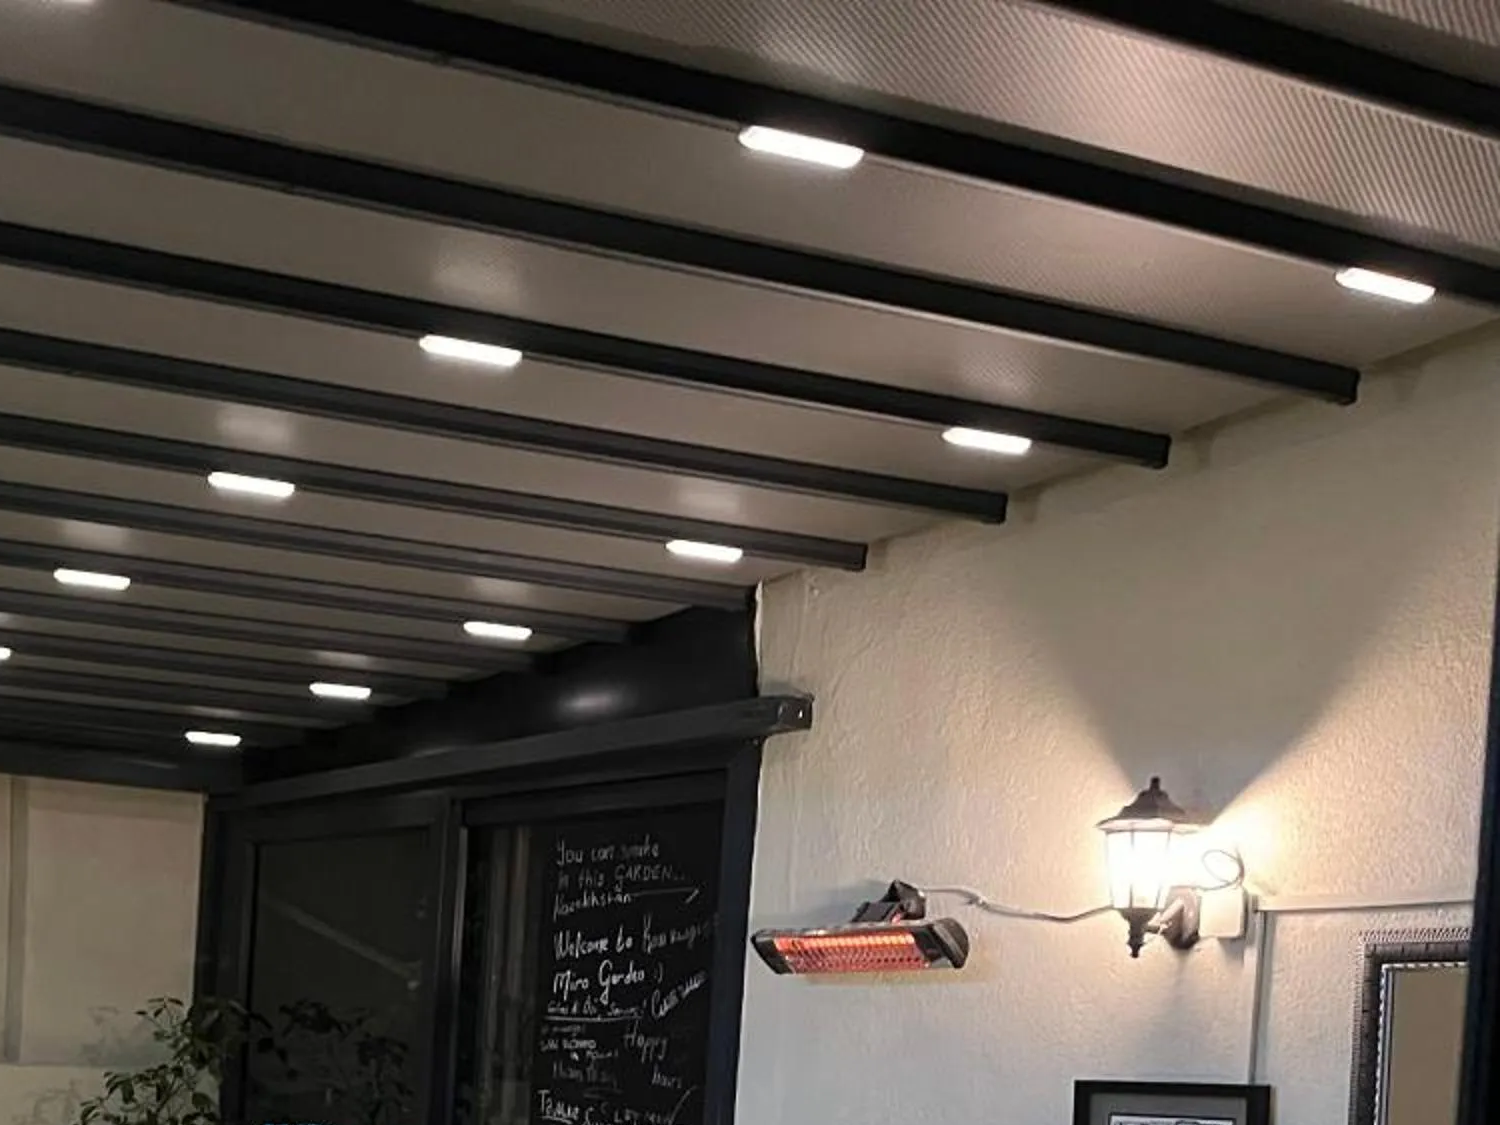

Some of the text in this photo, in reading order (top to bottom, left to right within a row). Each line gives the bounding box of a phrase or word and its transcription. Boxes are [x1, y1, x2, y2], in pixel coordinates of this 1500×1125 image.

[556, 838, 584, 866] You
[591, 844, 615, 862] can
[578, 868, 605, 888] this
[553, 929, 609, 960] Welcome
[616, 924, 634, 953] to
[623, 1019, 670, 1063] Happy
